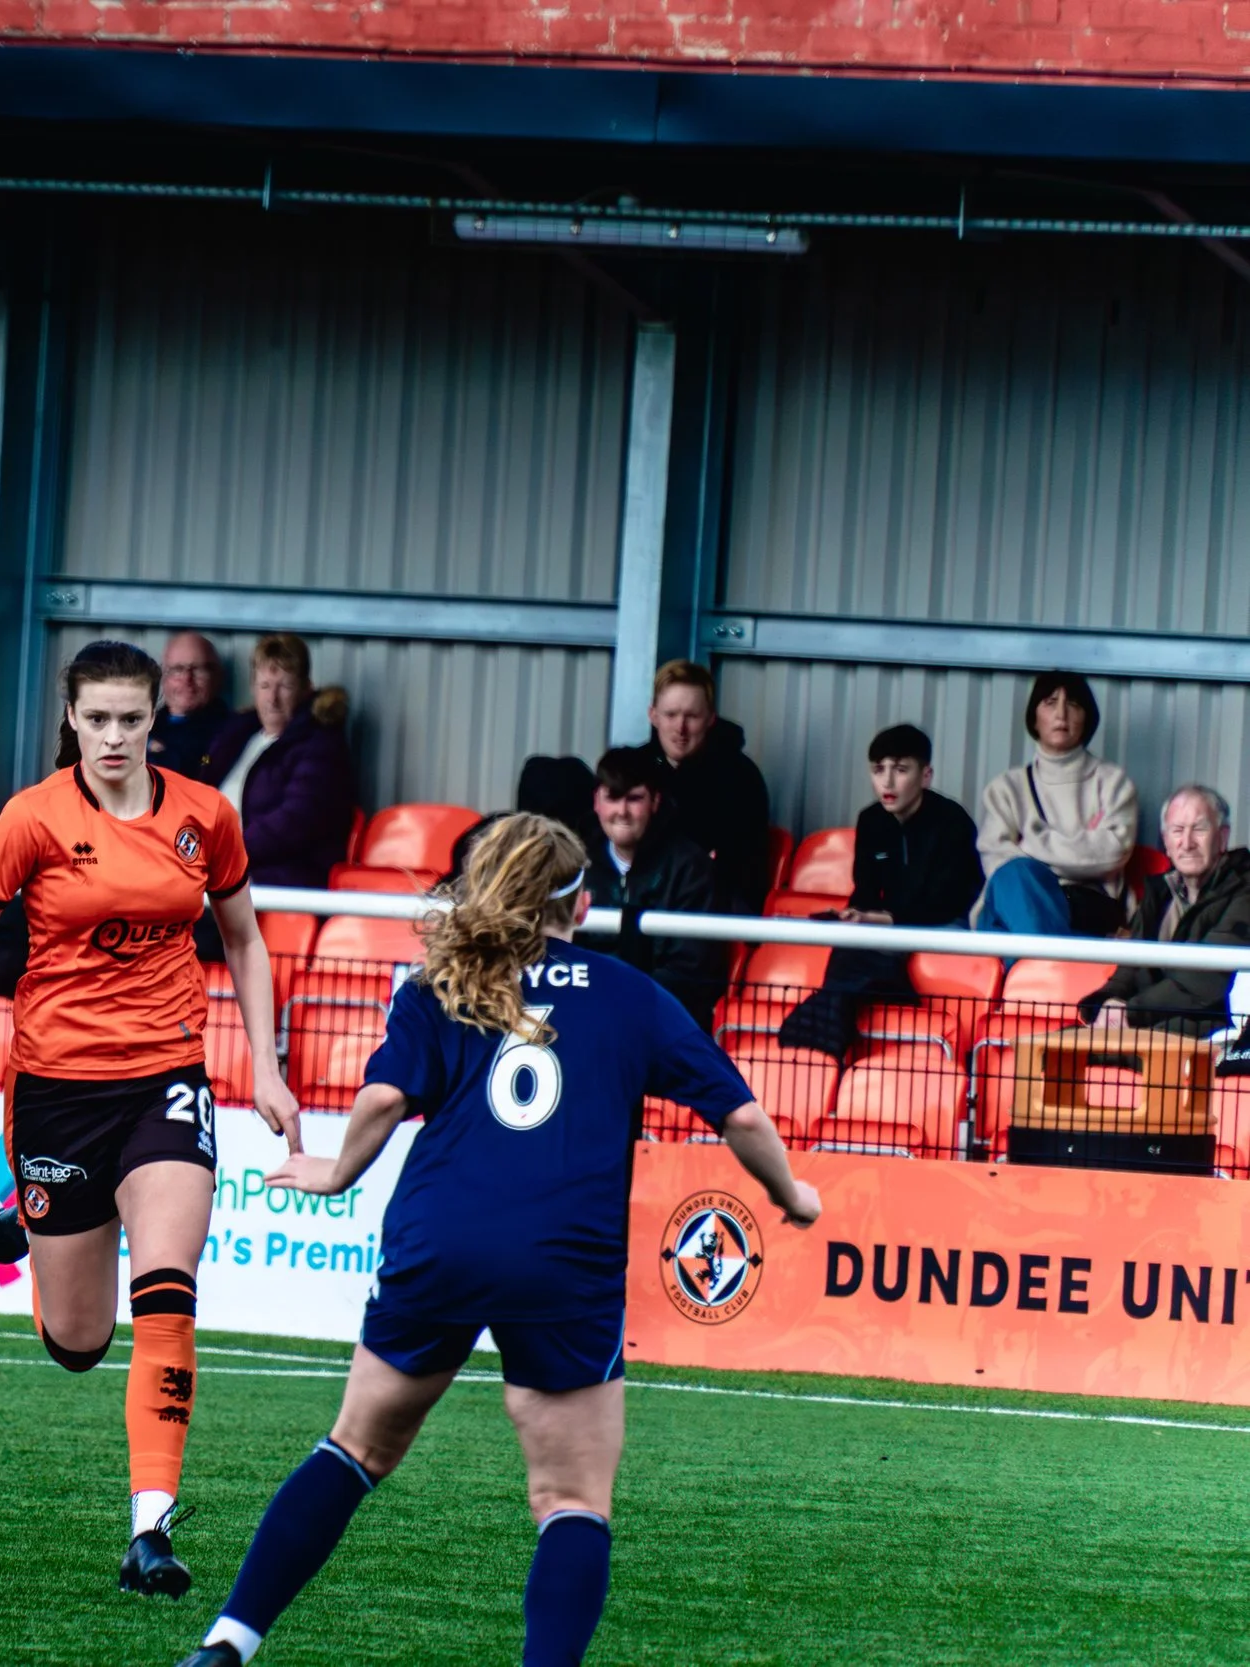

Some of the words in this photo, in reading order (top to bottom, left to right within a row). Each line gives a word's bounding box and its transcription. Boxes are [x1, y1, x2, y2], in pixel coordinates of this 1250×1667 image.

[516, 962, 590, 988] YCE
[487, 1004, 562, 1131] 6
[165, 1083, 213, 1135] 20
[24, 1162, 71, 1178] Paint-tec
[265, 1231, 383, 1274] Premi
[824, 1240, 1092, 1315] DUNDEE
[1122, 1261, 1250, 1325] UNI
